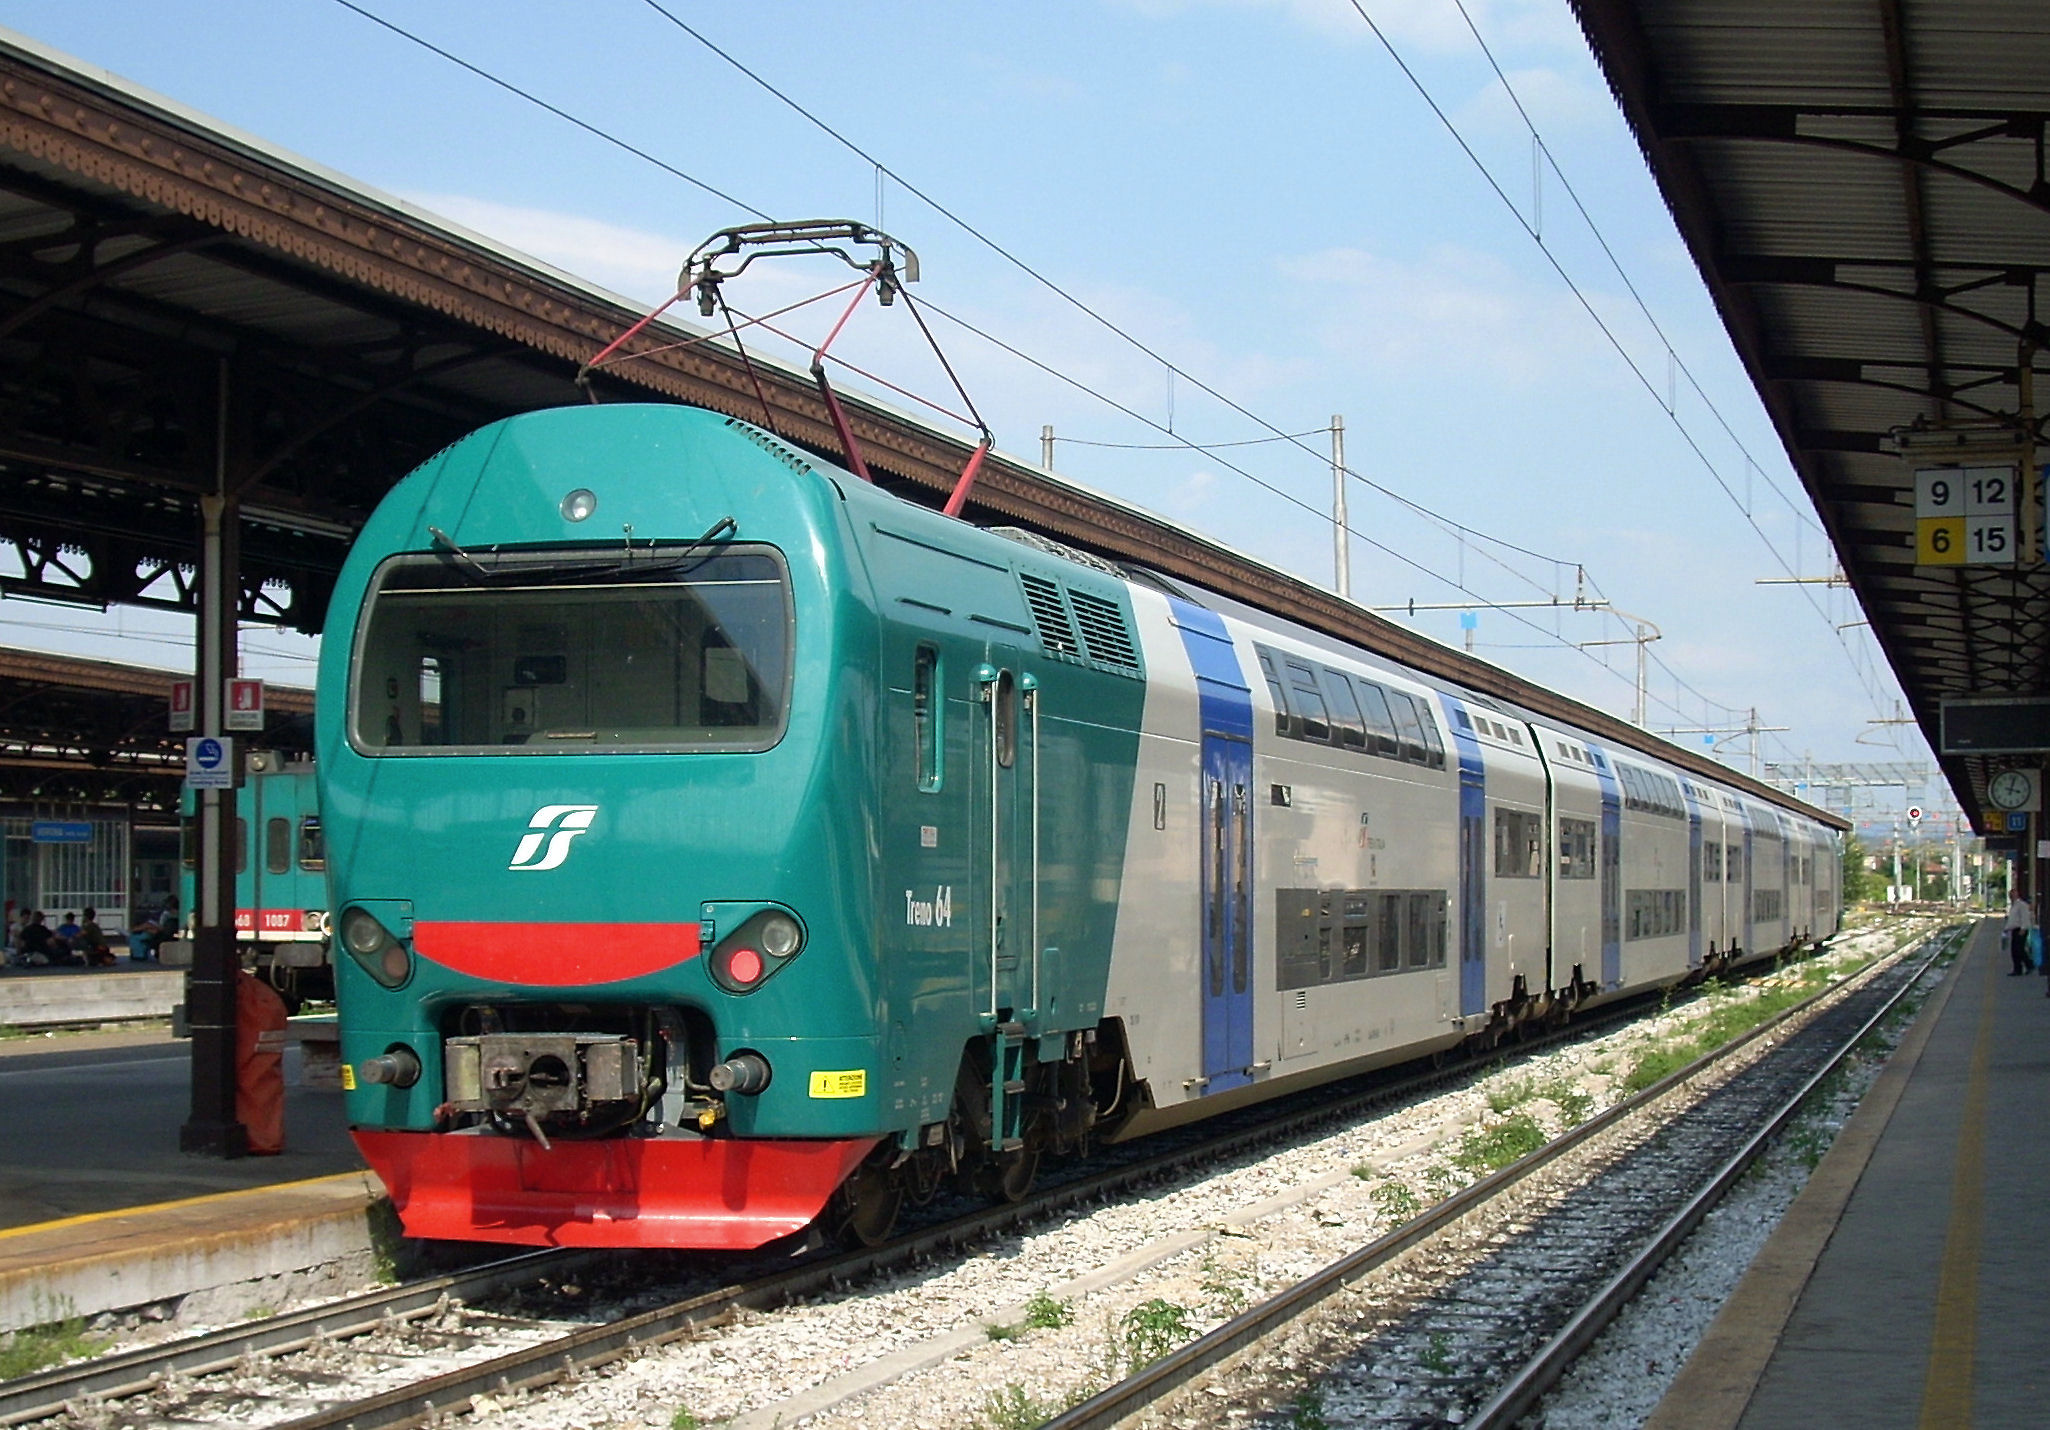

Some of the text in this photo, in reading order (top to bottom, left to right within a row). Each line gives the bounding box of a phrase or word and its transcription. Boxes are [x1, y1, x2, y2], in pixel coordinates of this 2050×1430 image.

[1931, 481, 1949, 506] 9
[1972, 478, 2005, 504] 12
[1932, 528, 1950, 553] 6
[1973, 527, 2005, 552] 15
[1155, 783, 1165, 830] 2
[905, 884, 951, 928] Treno 64
